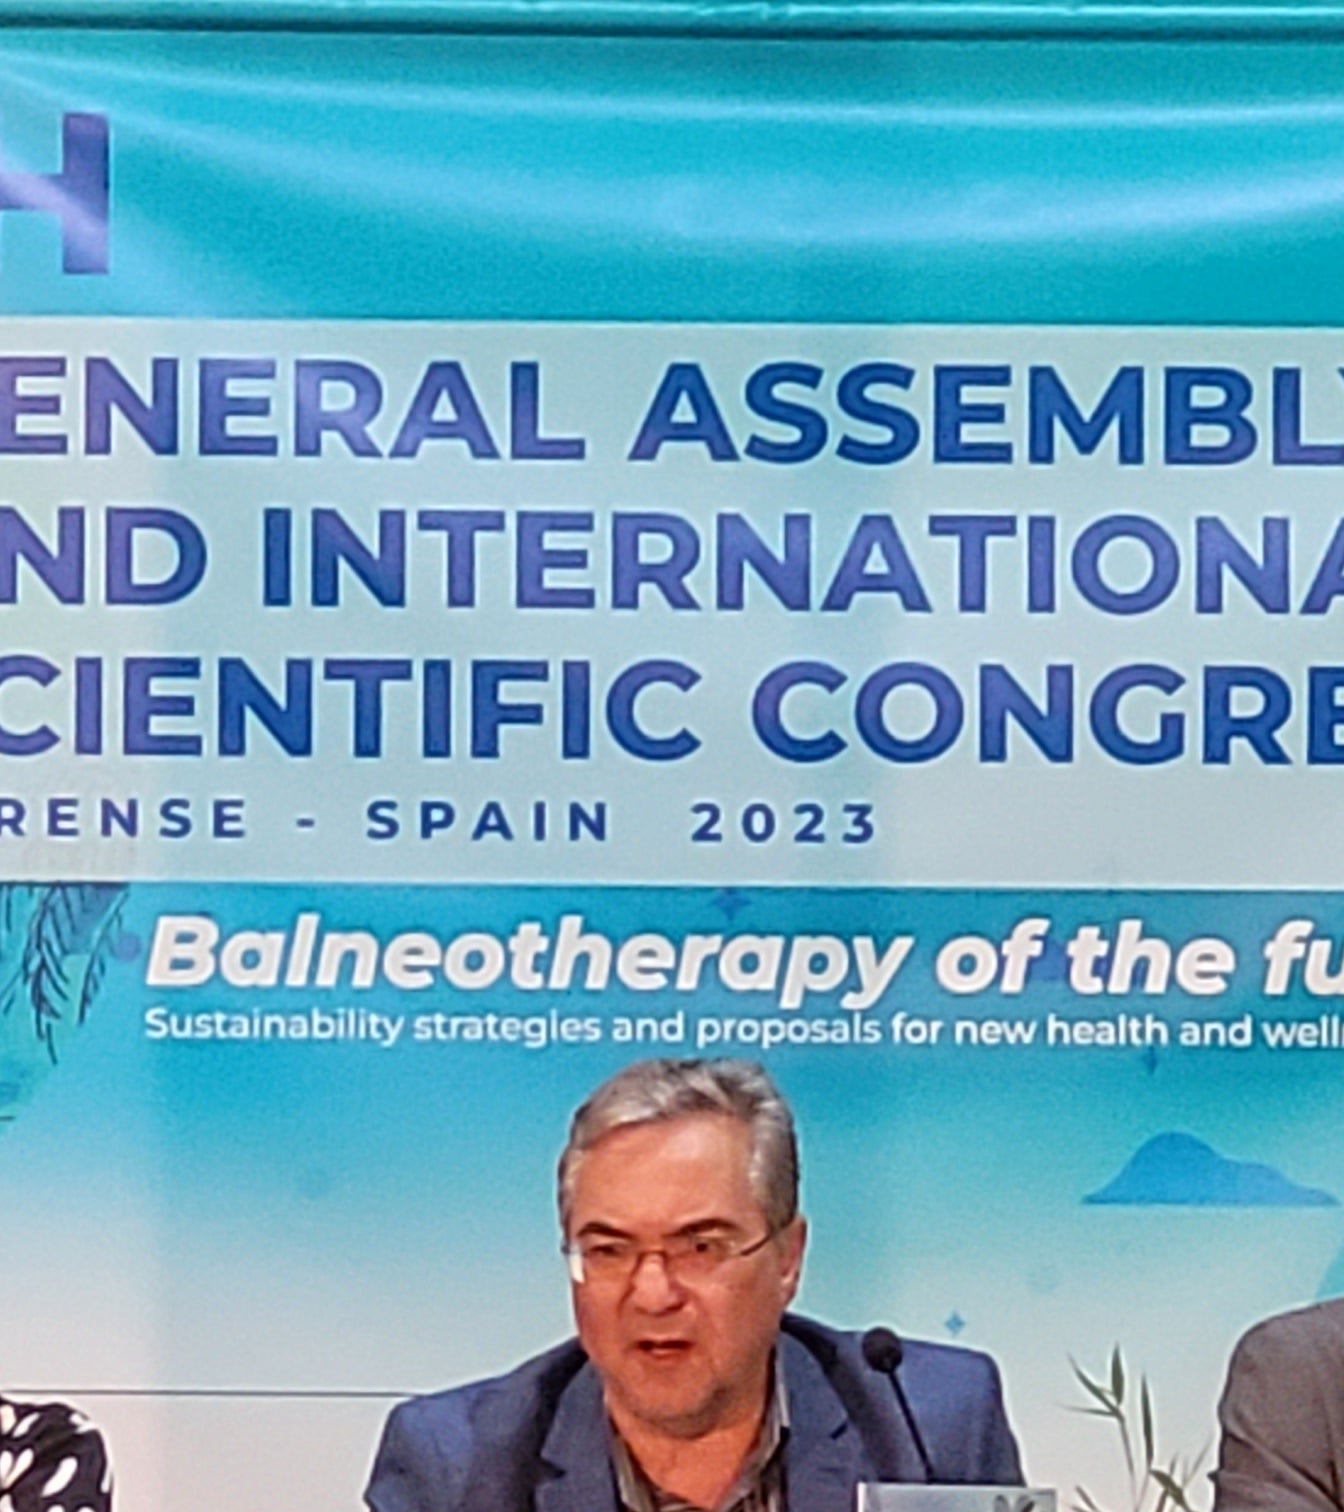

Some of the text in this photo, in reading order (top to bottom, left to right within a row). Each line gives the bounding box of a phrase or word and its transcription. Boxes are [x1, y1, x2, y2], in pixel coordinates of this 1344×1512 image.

[366, 801, 607, 841] SPAIN
[690, 803, 874, 843] 2023
[145, 912, 914, 1009] Balneotherapy
[936, 918, 1050, 994] of
[1067, 919, 1236, 995] the
[145, 1008, 405, 1047] Sustainability
[414, 1012, 600, 1048] strategies
[613, 1012, 684, 1042] and
[696, 1012, 881, 1048] proposals
[893, 1012, 943, 1044] for
[956, 1018, 1036, 1045] new
[1047, 1014, 1168, 1046] health
[1180, 1014, 1252, 1046] and
